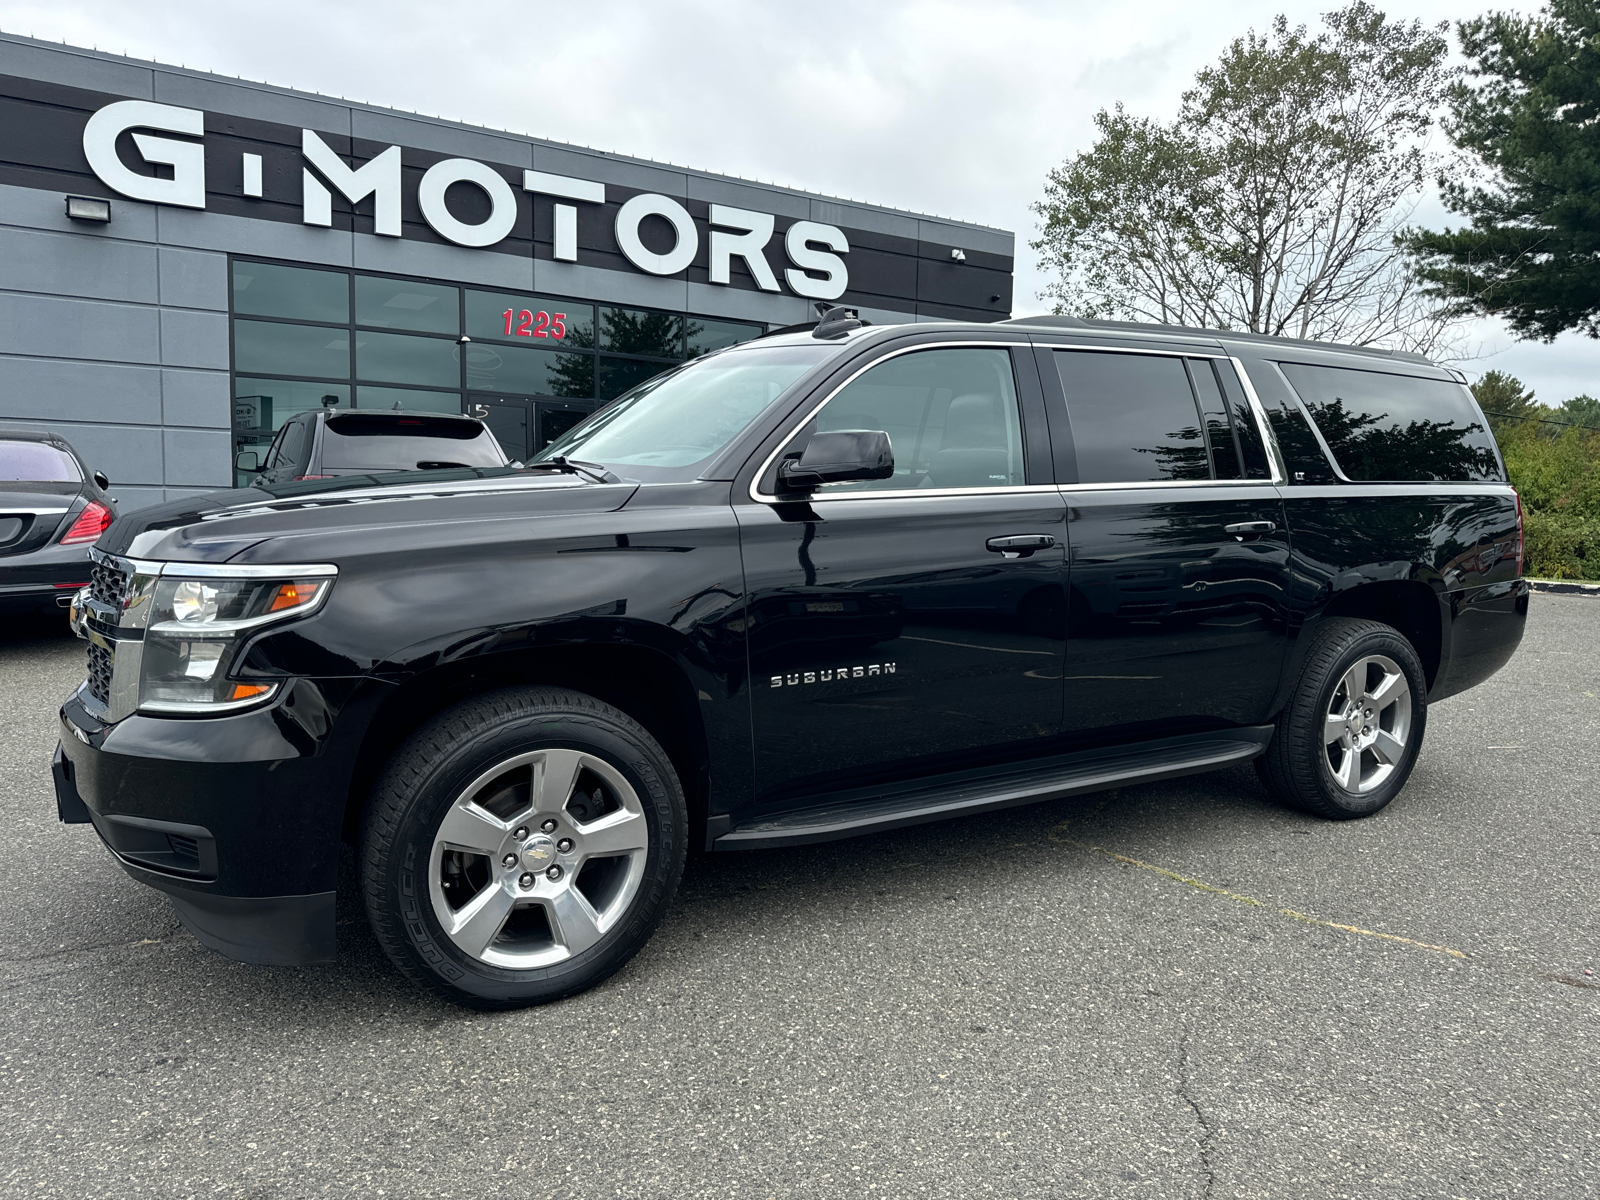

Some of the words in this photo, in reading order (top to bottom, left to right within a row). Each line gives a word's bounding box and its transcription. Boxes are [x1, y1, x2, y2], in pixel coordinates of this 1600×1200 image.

[502, 308, 567, 340] 1225
[1294, 471, 1306, 481] LT
[770, 662, 896, 688] SUBURBAN
[629, 758, 674, 941] BRIDGESTONE
[400, 842, 466, 983] DUELER
